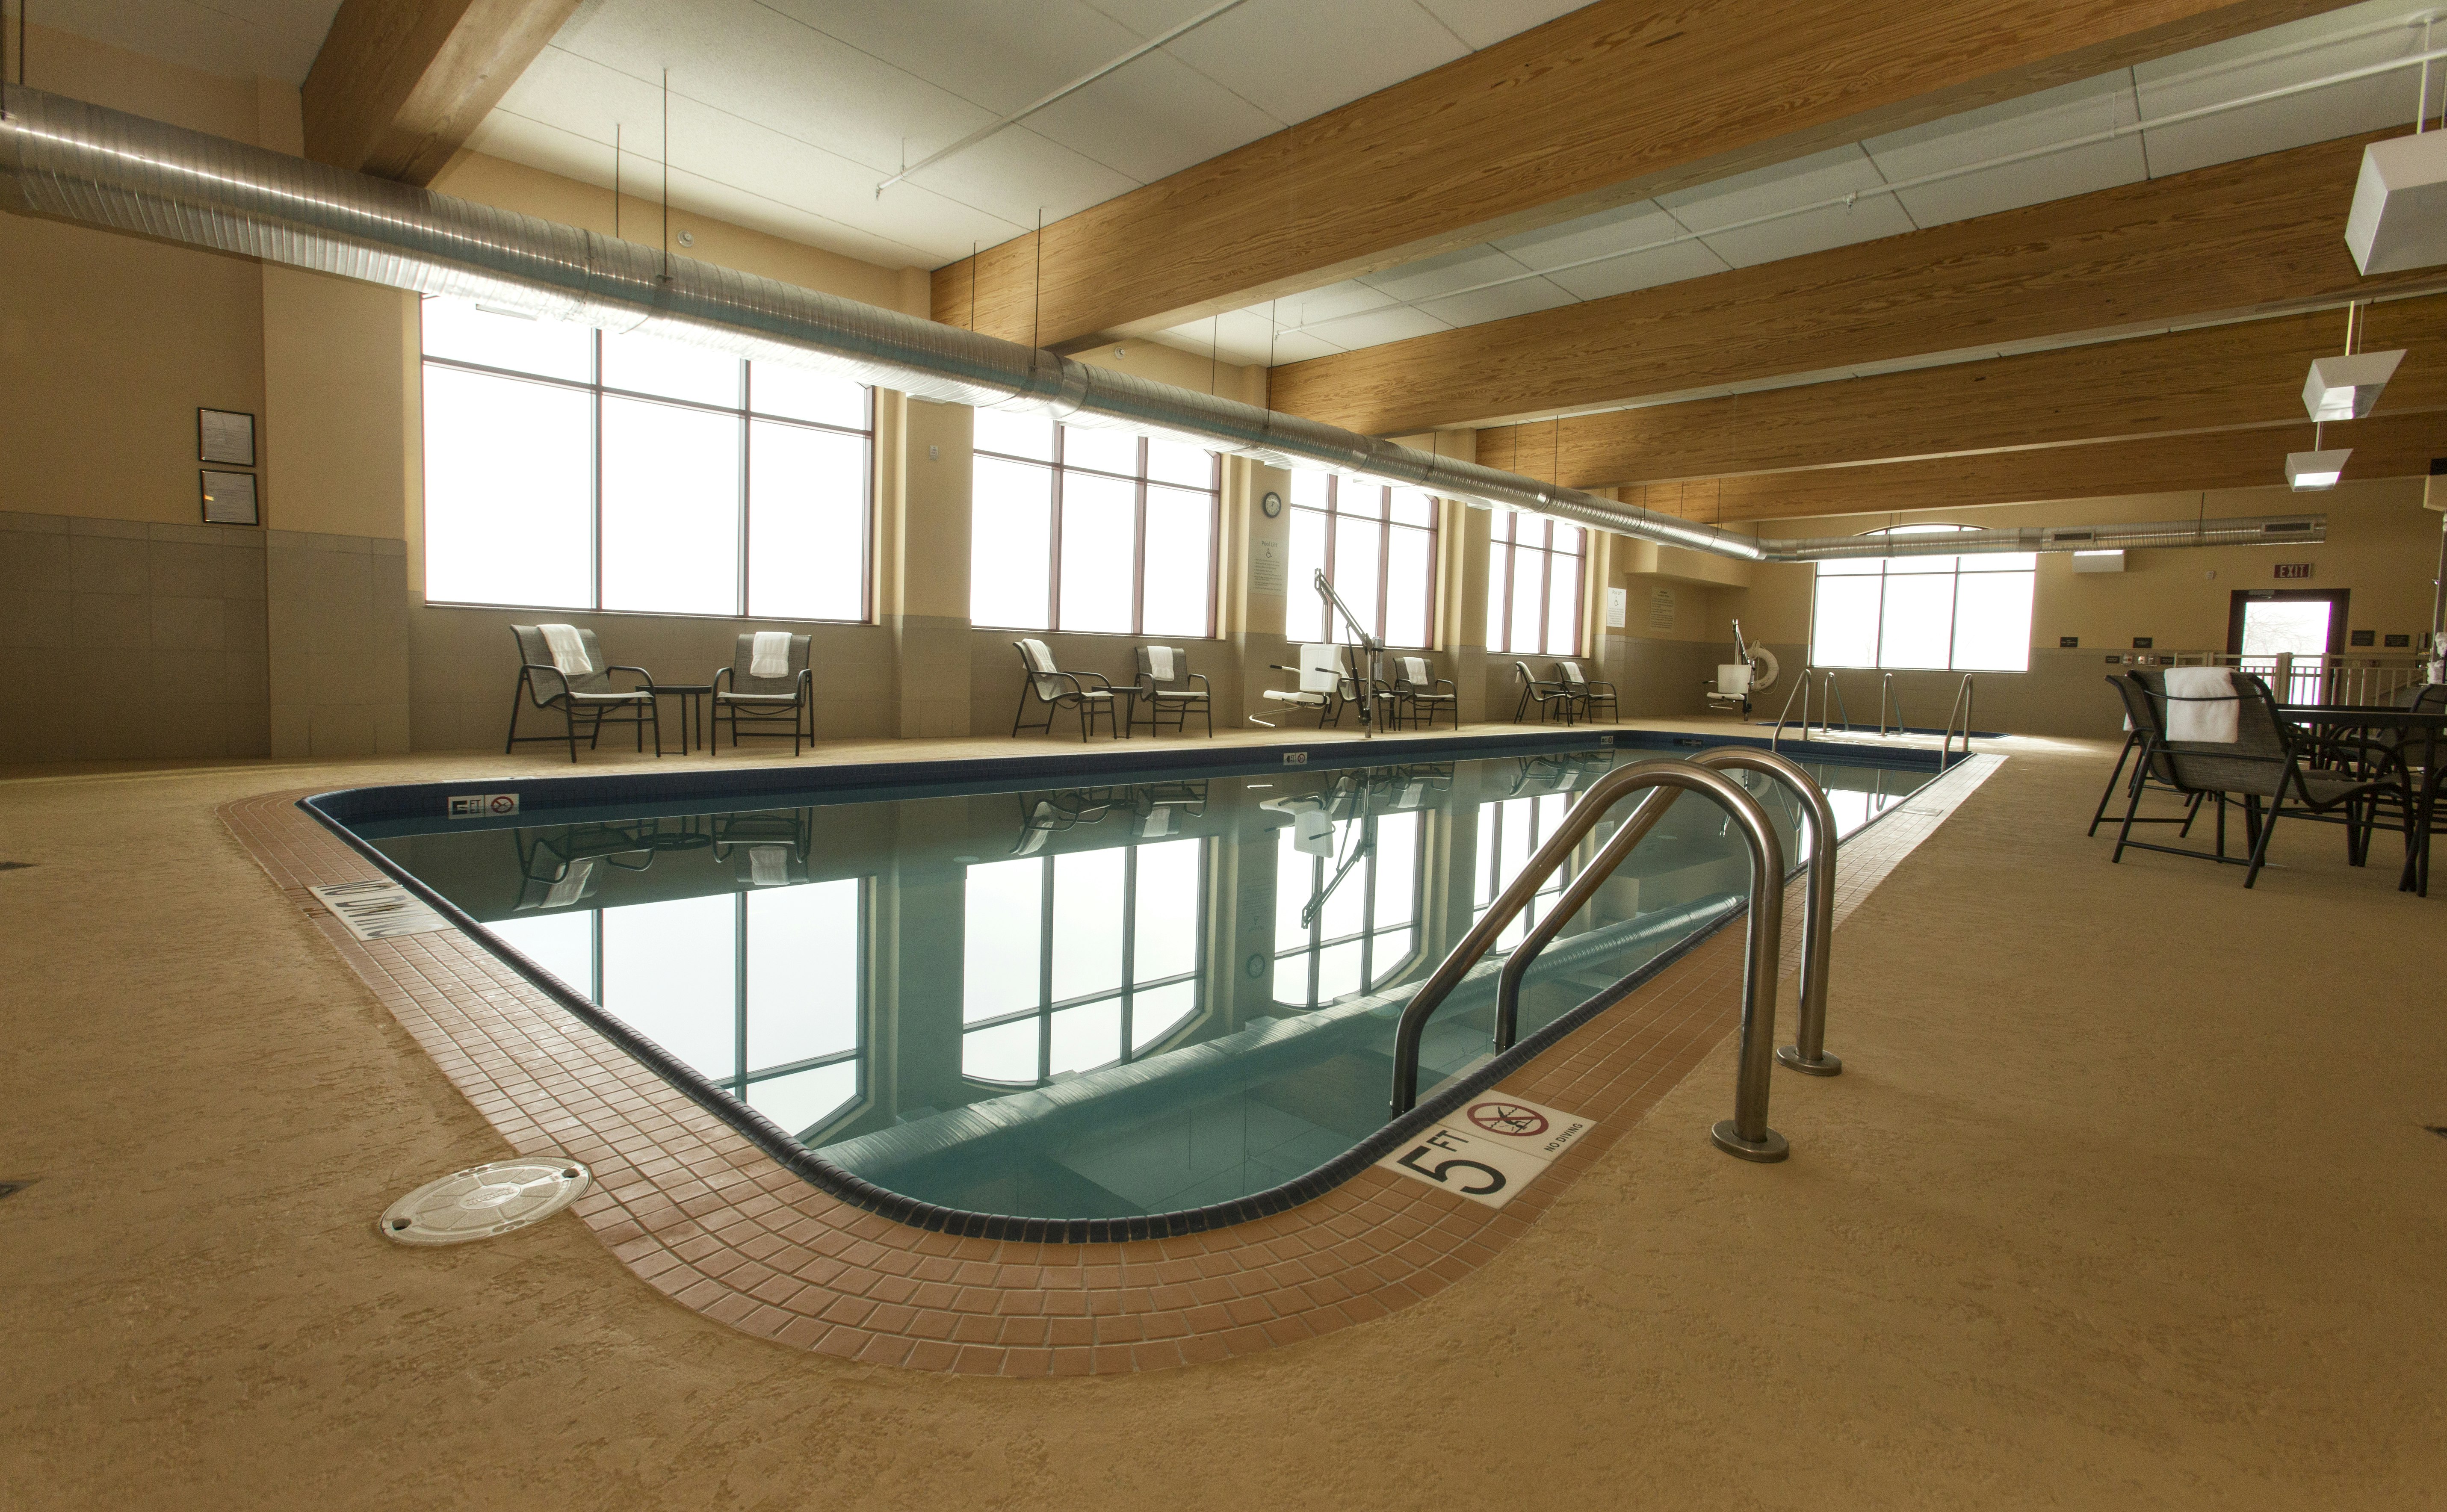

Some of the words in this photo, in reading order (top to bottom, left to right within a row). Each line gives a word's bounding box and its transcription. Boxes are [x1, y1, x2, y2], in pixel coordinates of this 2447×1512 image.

[2280, 565, 2305, 577] EXIT
[317, 879, 391, 895] NO
[1426, 1130, 1469, 1152] FT
[1544, 1142, 1560, 1152] NO
[1555, 1123, 1583, 1142] DIVING
[1397, 1145, 1507, 1195] 5
